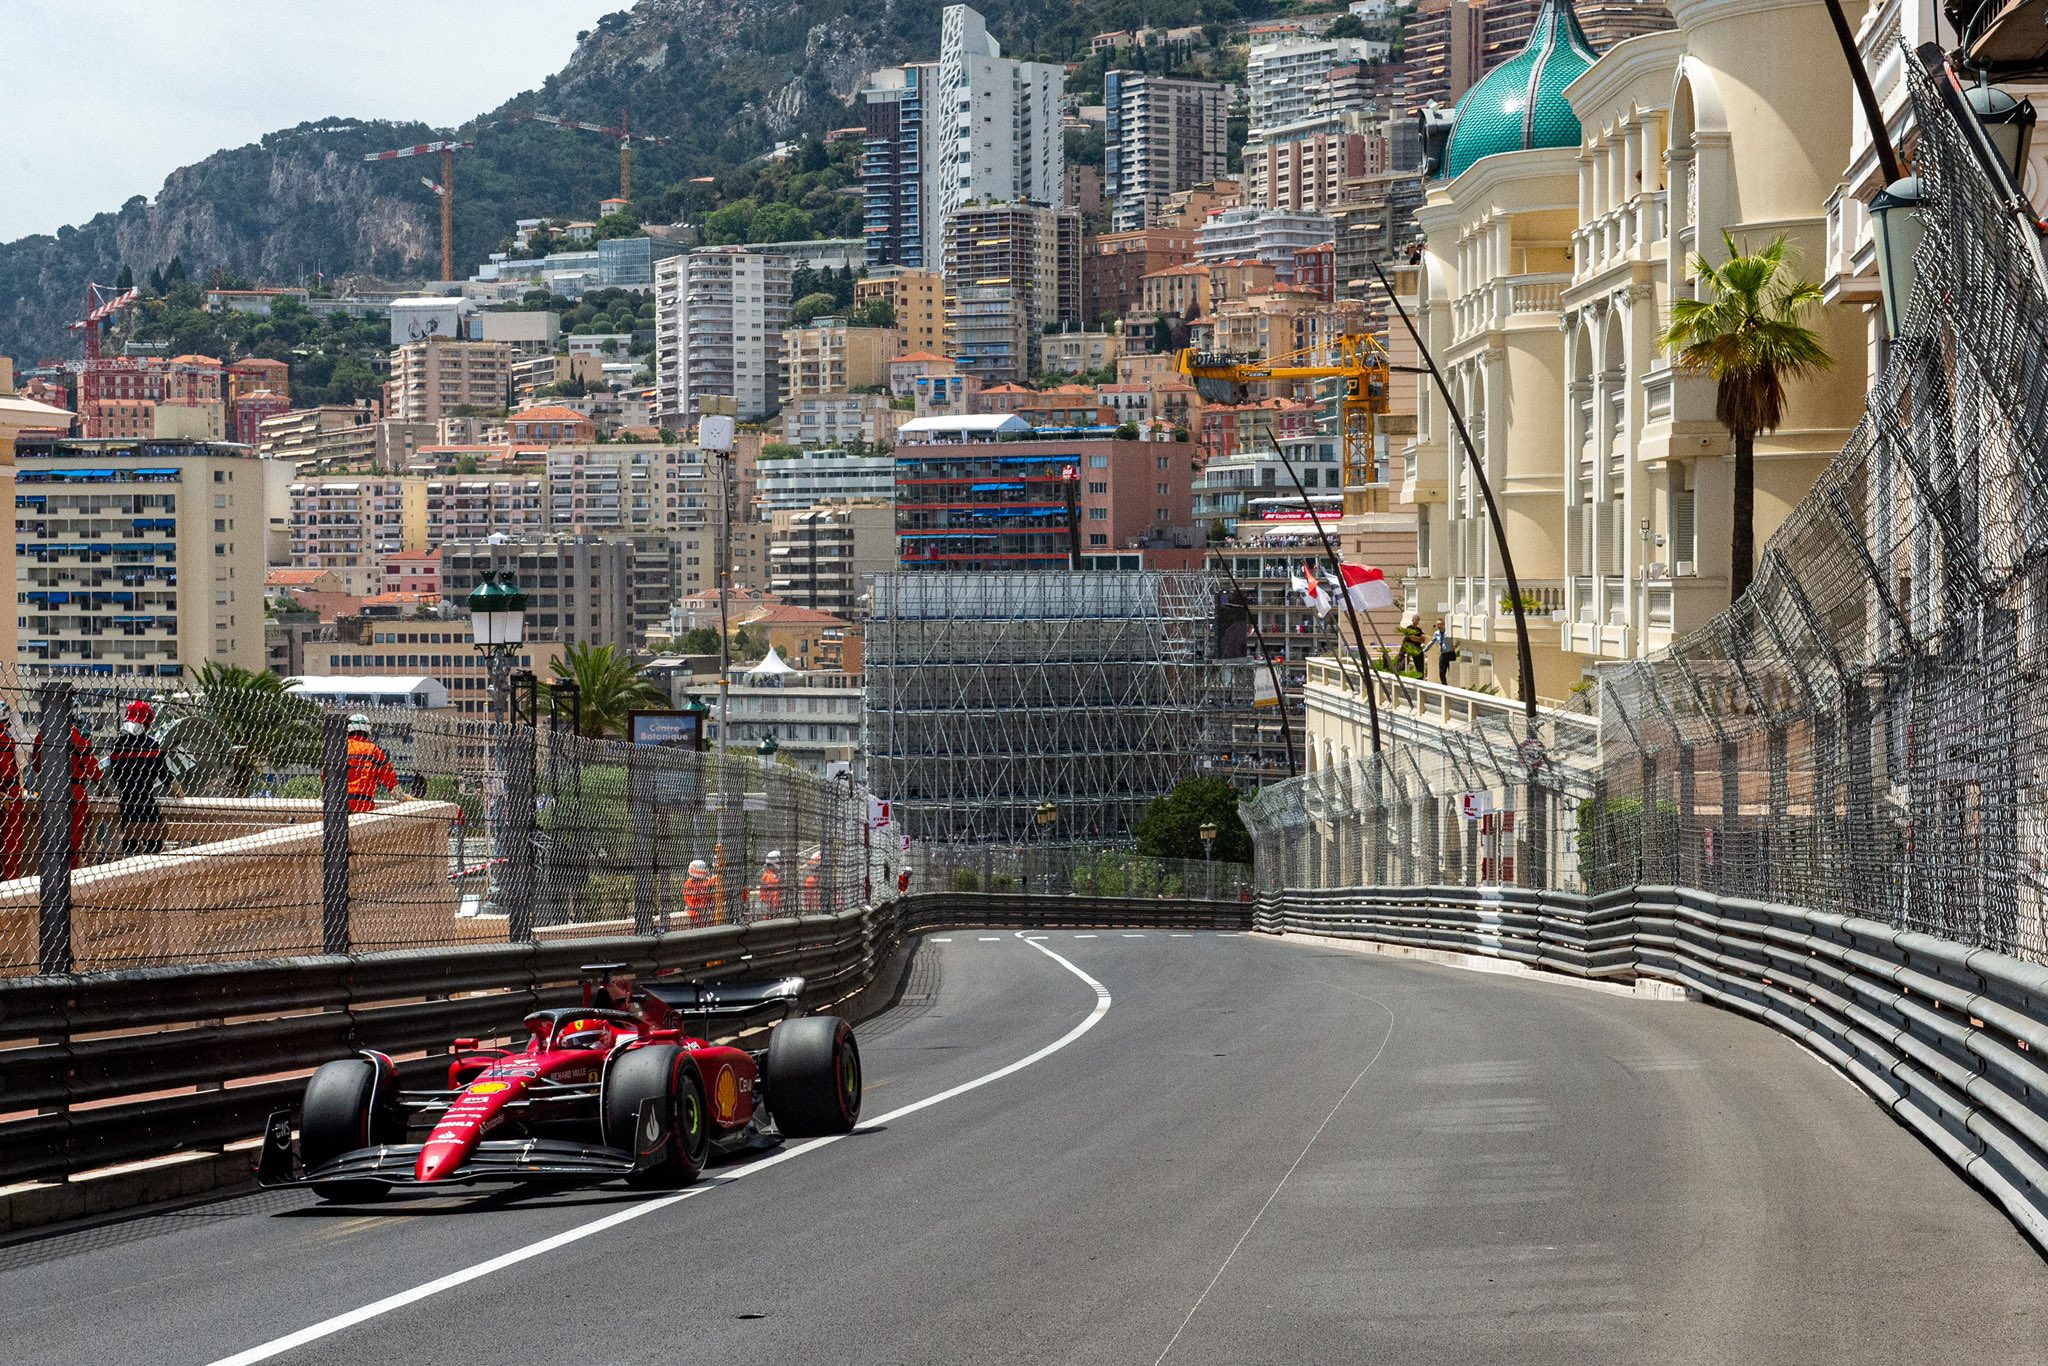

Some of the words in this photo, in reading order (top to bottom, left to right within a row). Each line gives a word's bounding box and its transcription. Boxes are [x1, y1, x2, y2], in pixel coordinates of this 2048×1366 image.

[641, 732, 688, 742] Botanique
[550, 1070, 572, 1081] RICHARD
[572, 1068, 586, 1077] MILLE
